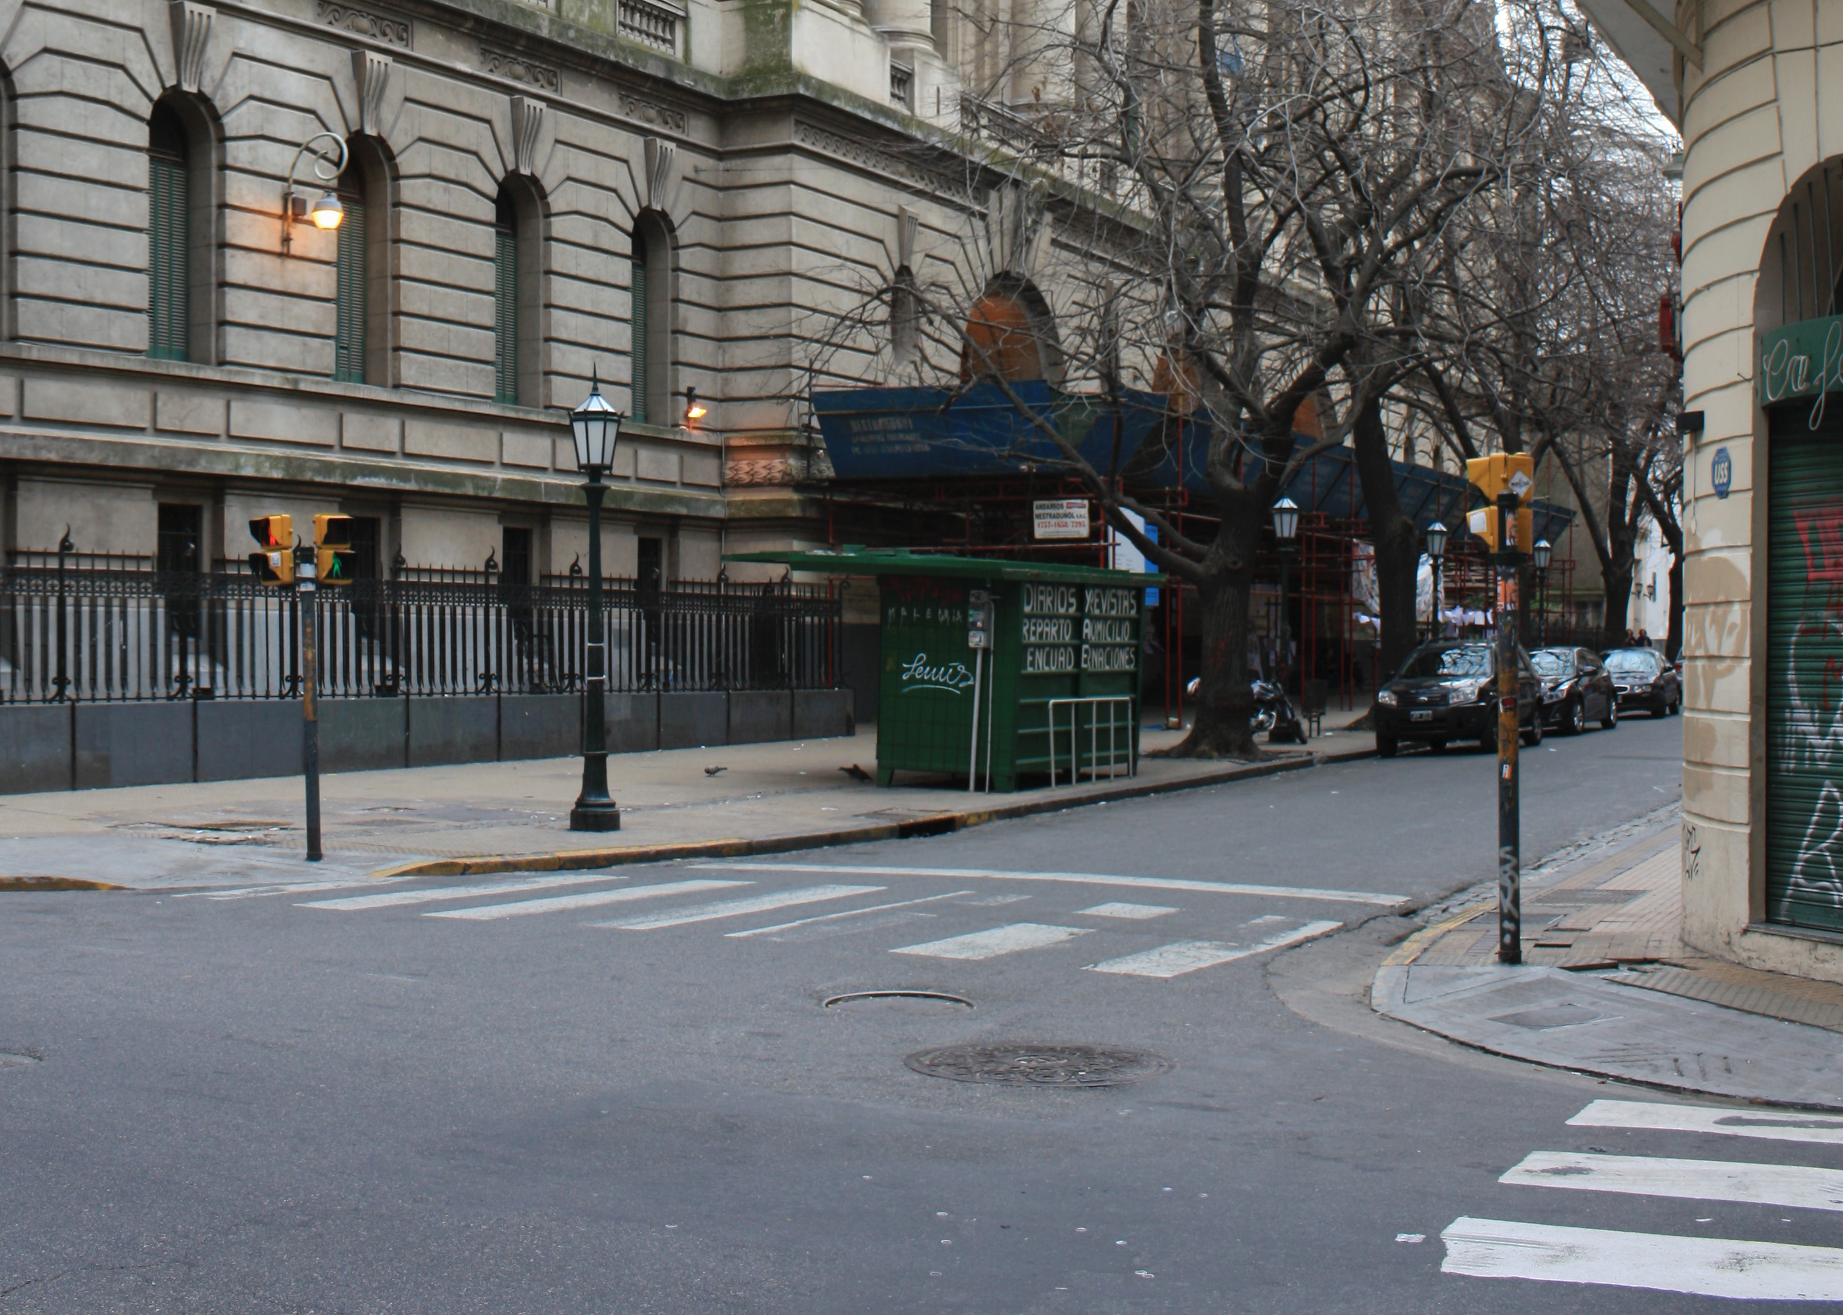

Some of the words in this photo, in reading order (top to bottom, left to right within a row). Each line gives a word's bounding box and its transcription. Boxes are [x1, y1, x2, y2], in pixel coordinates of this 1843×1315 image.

[1762, 320, 1843, 430] Caf
[1024, 584, 1076, 614] DIARIOS
[1022, 618, 1072, 641] REPARTO
[1027, 647, 1075, 671] ENCUAD
